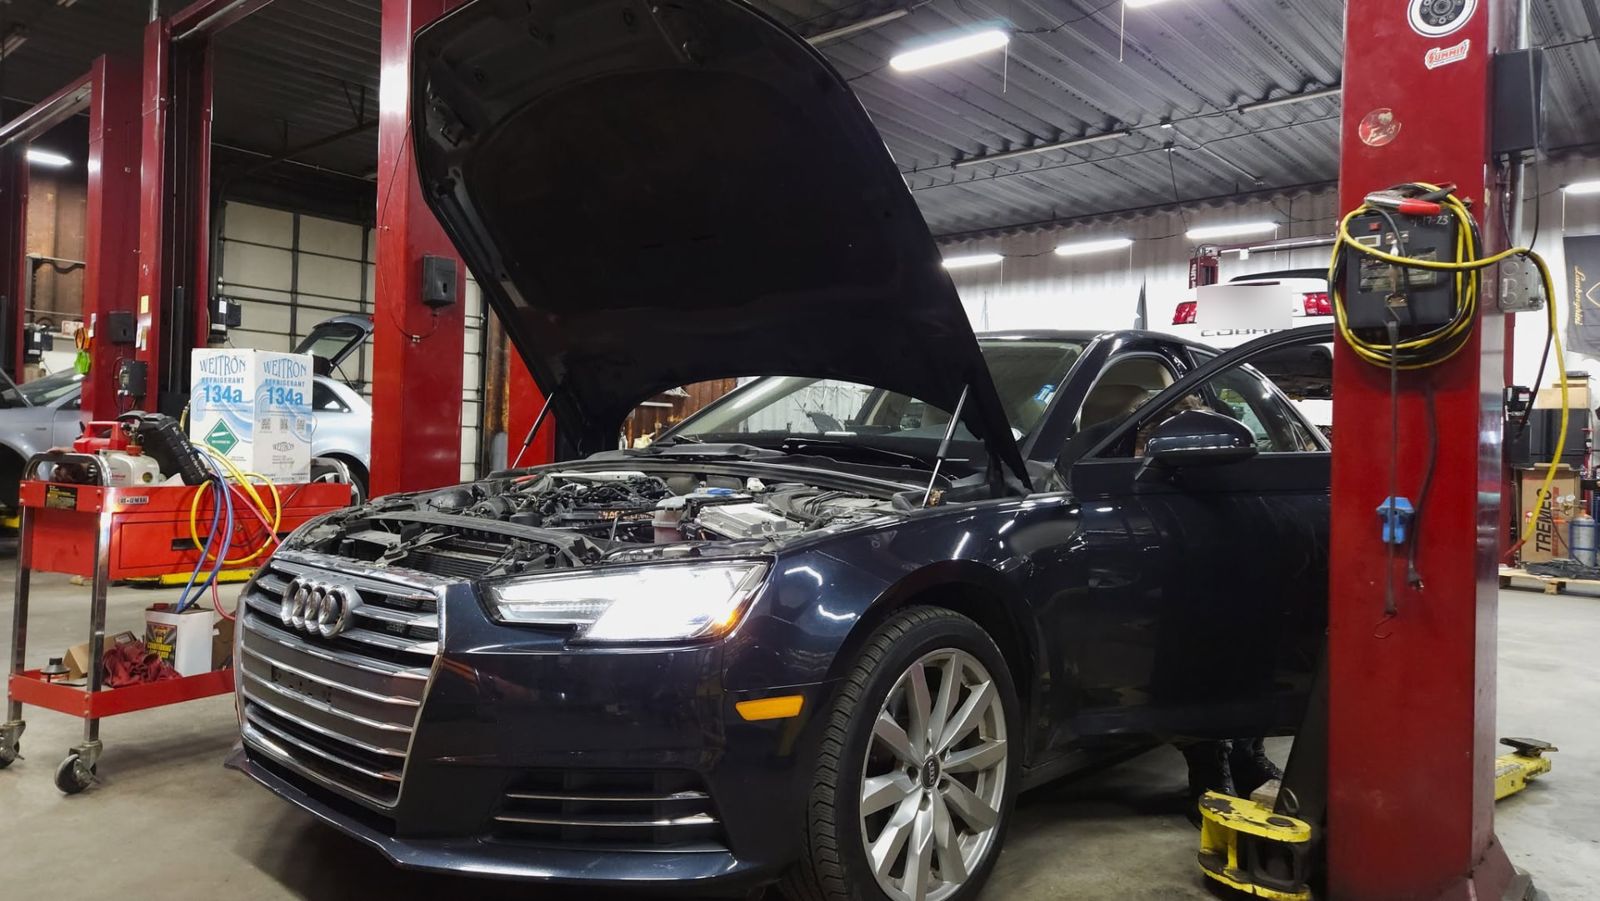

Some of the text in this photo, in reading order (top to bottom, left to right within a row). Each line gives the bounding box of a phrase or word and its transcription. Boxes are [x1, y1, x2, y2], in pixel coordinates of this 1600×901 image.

[1573, 265, 1585, 325] Lamborghini
[203, 385, 243, 403] 134a
[266, 386, 303, 405] 134a
[1535, 488, 1552, 552] TREMEC
